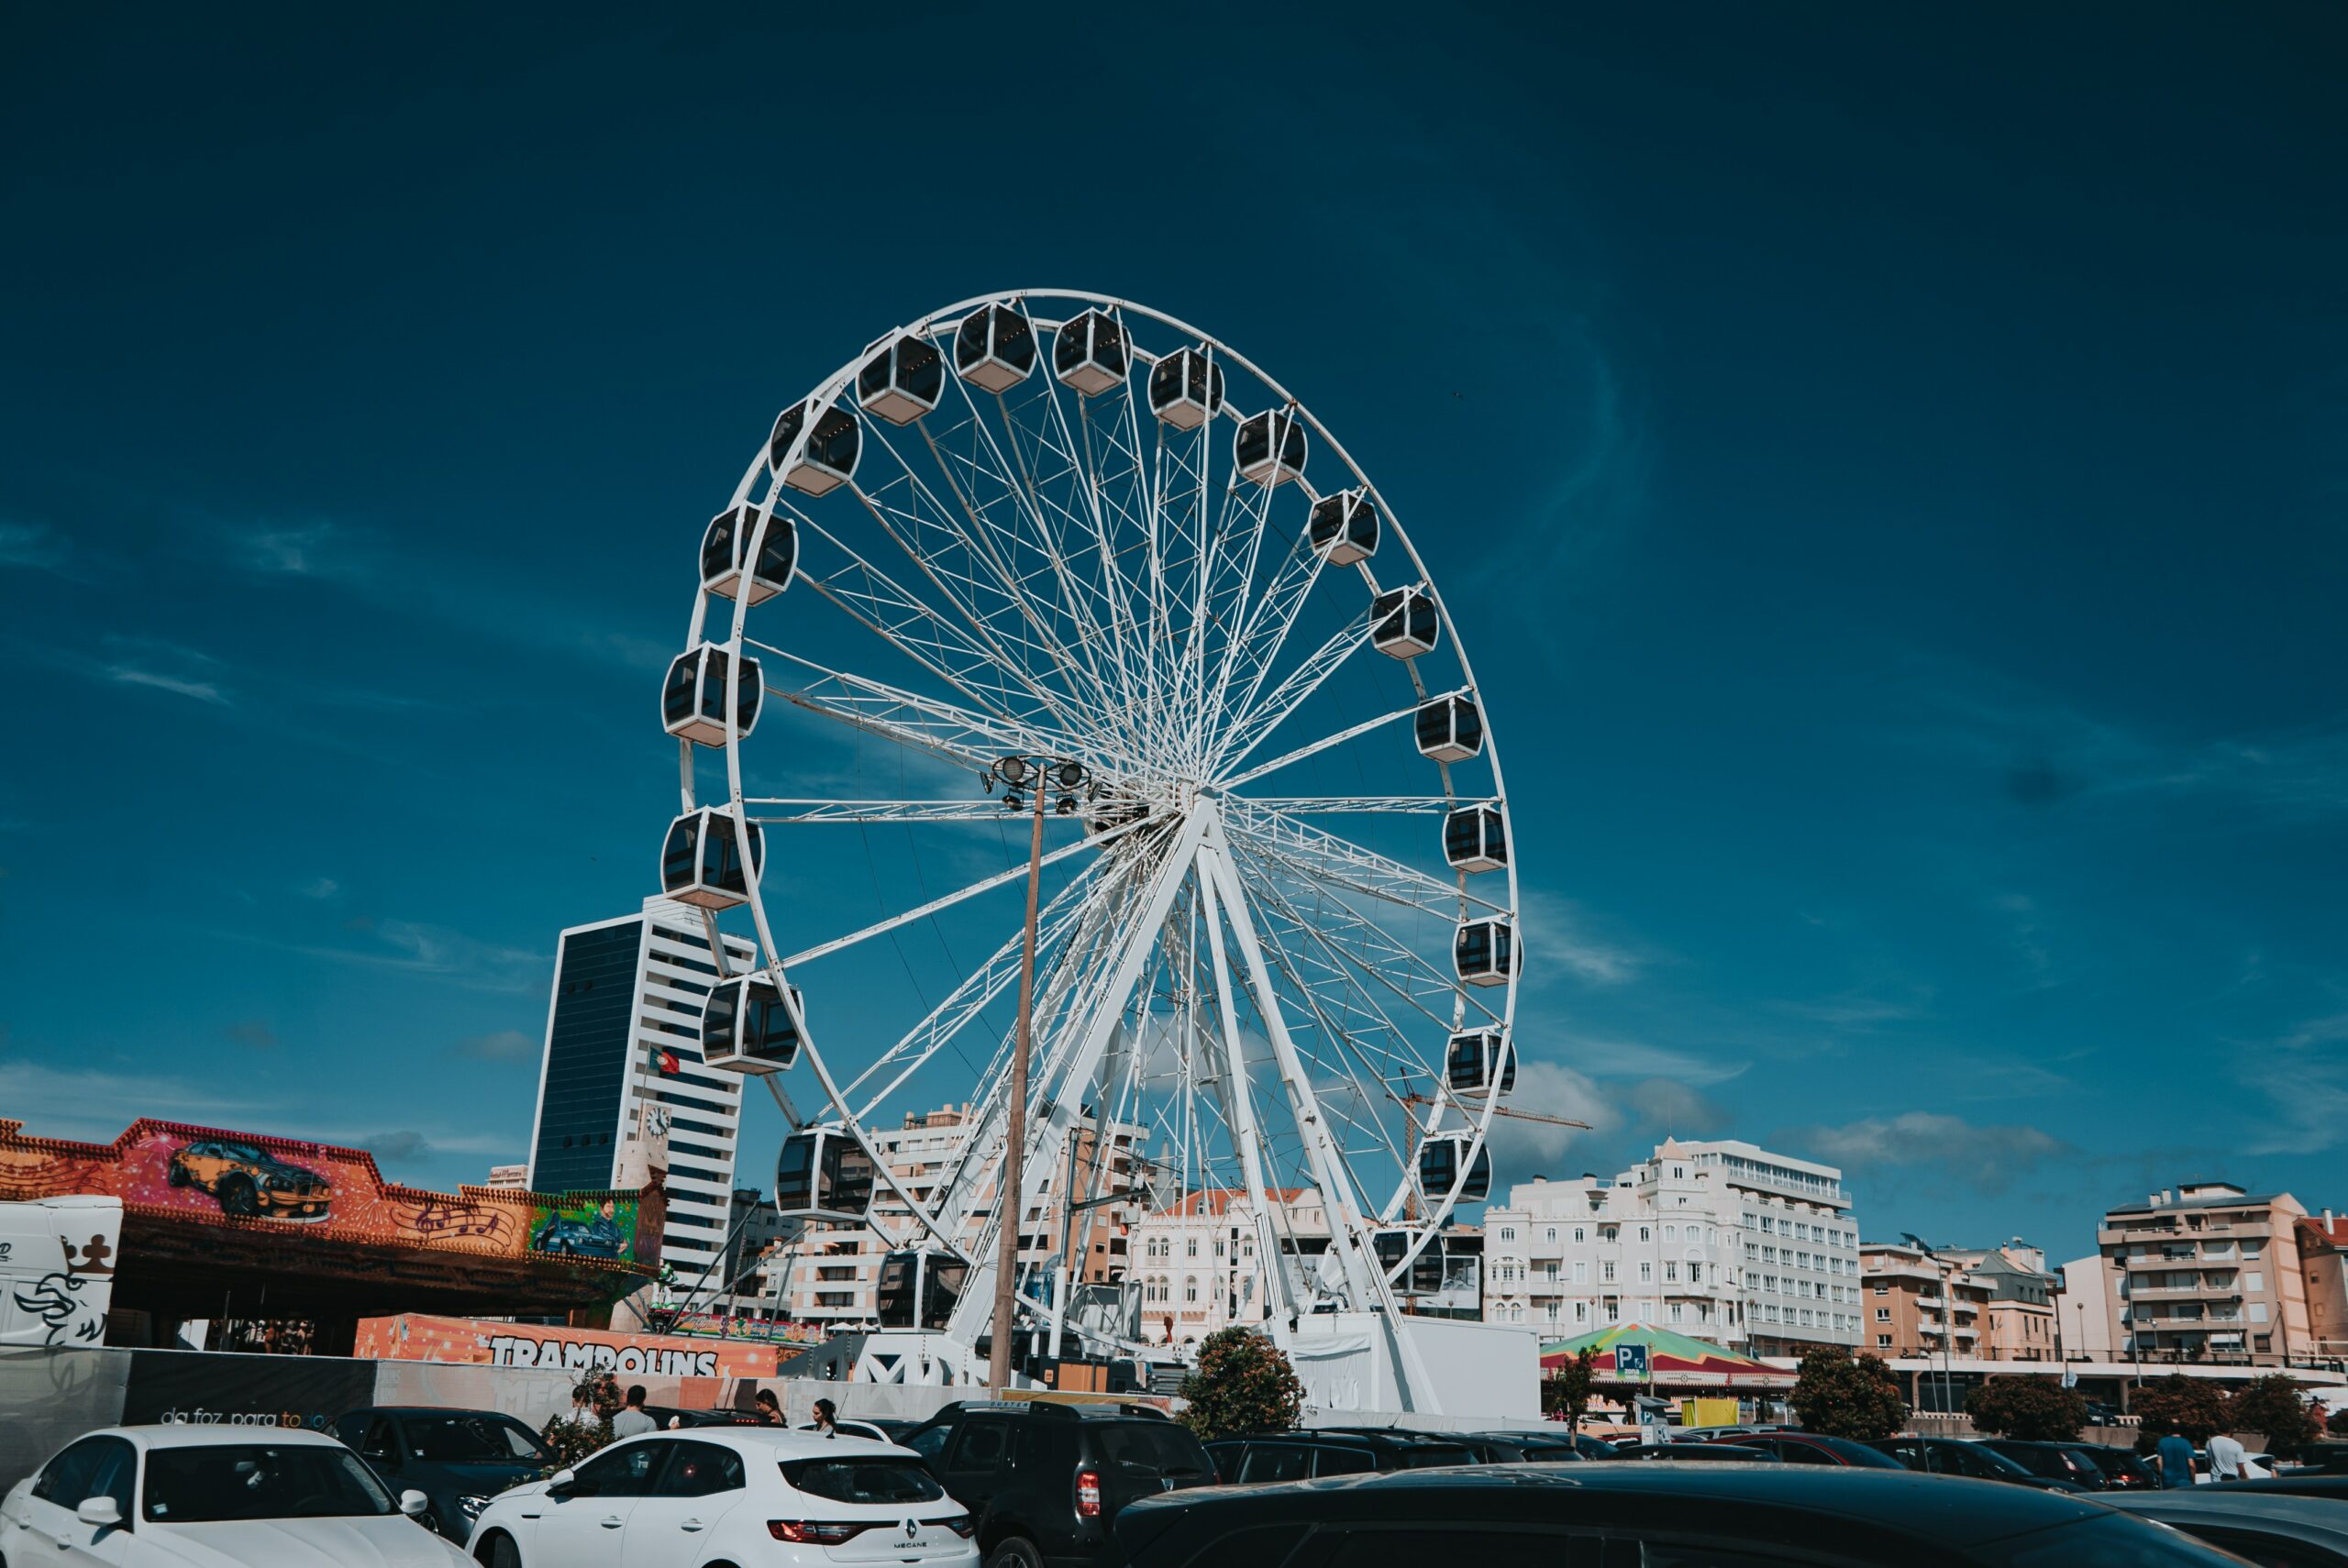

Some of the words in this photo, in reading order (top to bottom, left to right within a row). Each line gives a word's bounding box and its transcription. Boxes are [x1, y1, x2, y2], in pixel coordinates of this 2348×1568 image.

[490, 1335, 719, 1377] TRAMPOLINS
[1619, 1348, 1633, 1368] P
[161, 1408, 188, 1425] da
[194, 1408, 224, 1425] foz
[231, 1413, 277, 1426] para
[1644, 1411, 1651, 1423] P
